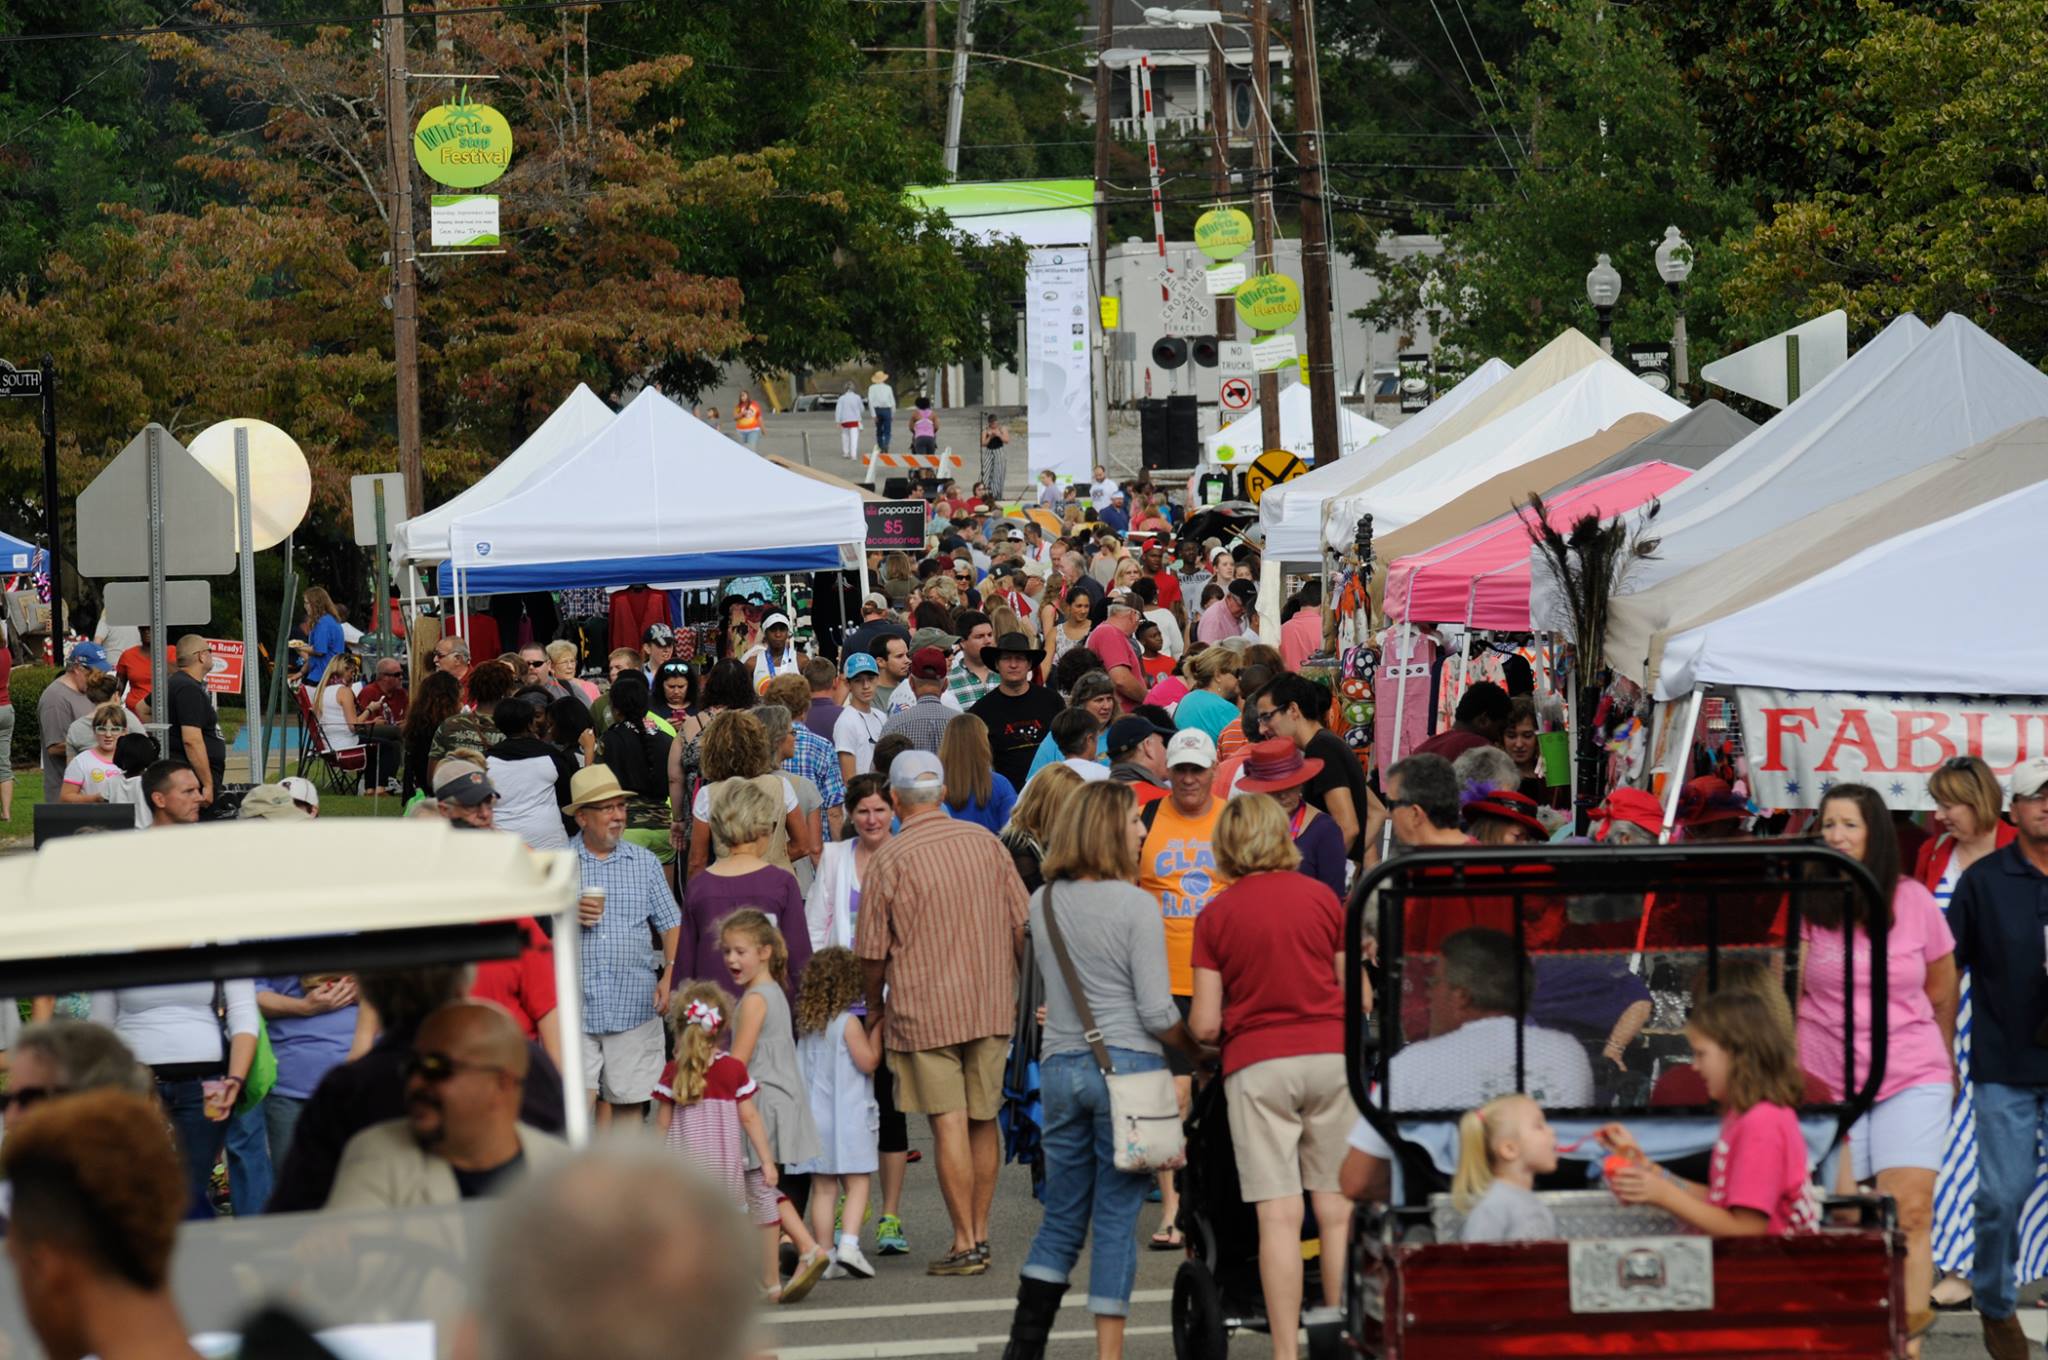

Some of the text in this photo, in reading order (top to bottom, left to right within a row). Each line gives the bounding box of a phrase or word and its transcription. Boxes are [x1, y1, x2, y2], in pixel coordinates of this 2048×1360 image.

[416, 121, 493, 151] Whistle
[441, 146, 509, 165] Festival
[1159, 270, 1178, 292] RAIL
[1162, 270, 1204, 319] CROSSING
[1187, 296, 1209, 318] ROAD
[1230, 346, 1242, 356] NO
[1632, 351, 1669, 360] WHISTLE STOP
[1222, 361, 1251, 370] TRUCKS
[1639, 359, 1662, 368] DISTRICT
[3, 373, 39, 387] SOUTH
[1252, 476, 1265, 492] R
[879, 504, 923, 516] paparazzi
[884, 518, 904, 535] $5
[866, 536, 921, 545] accessories
[218, 642, 243, 654] Ready!
[1759, 706, 2048, 776] FABU
[1155, 849, 1217, 878] CLA
[1162, 891, 1215, 917] CLAS
